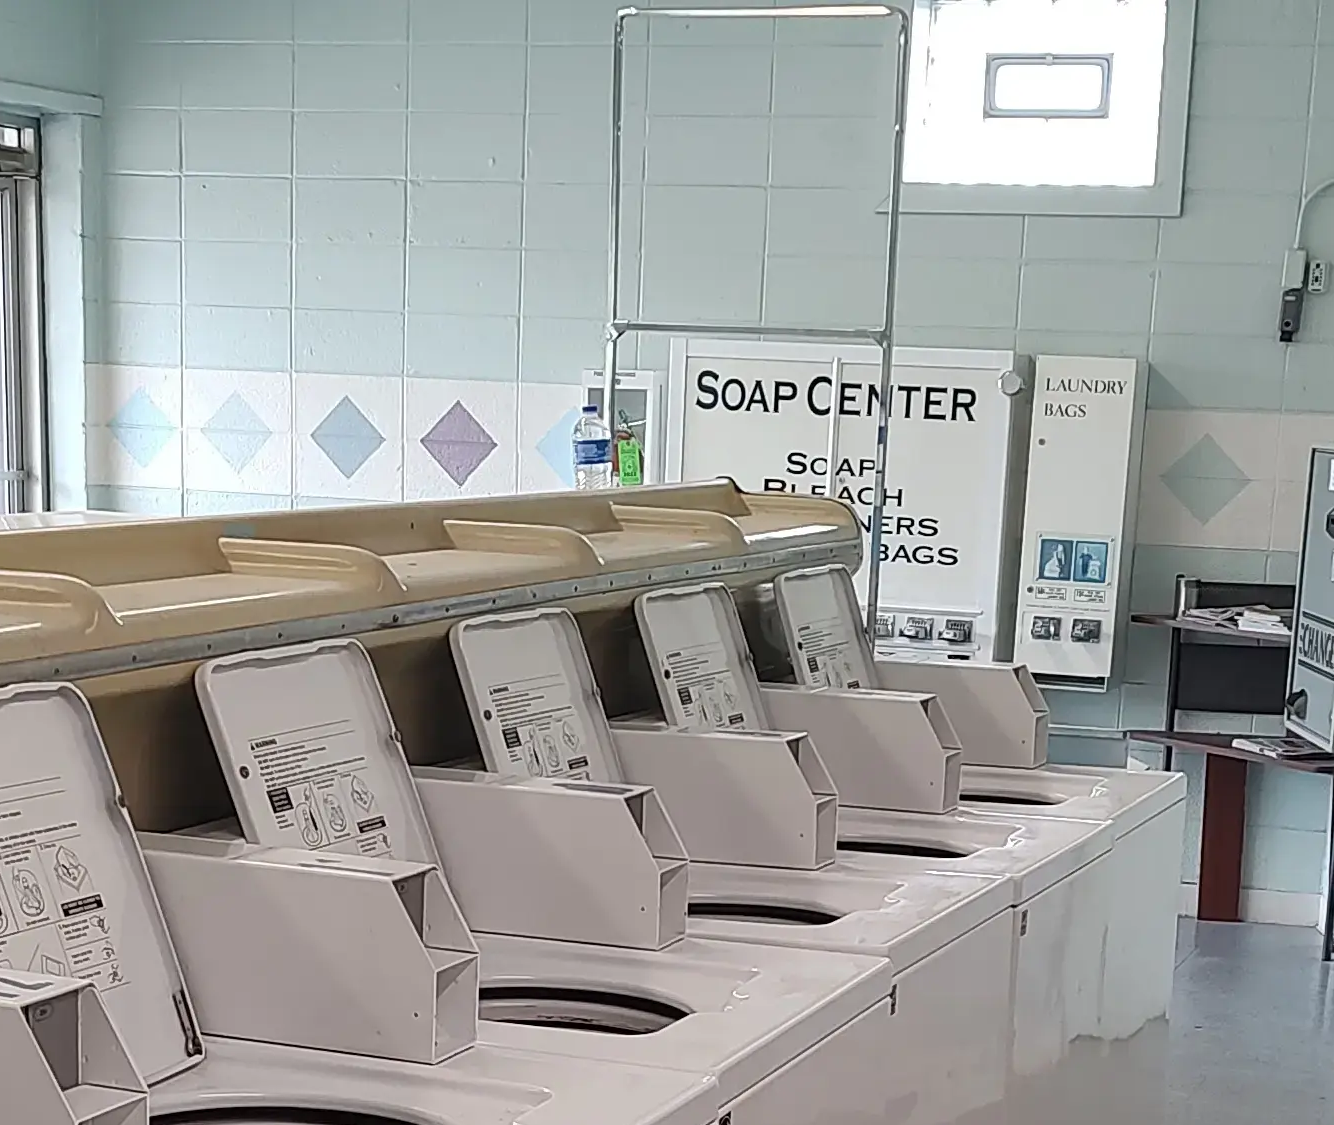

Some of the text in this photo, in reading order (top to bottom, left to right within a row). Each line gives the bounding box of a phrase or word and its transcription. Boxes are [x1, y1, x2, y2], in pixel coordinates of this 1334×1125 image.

[695, 369, 977, 422] SOAP CENTER
[1045, 376, 1128, 396] LAUNDRY
[1044, 402, 1087, 419] BAGS
[786, 452, 876, 478] SOAP
